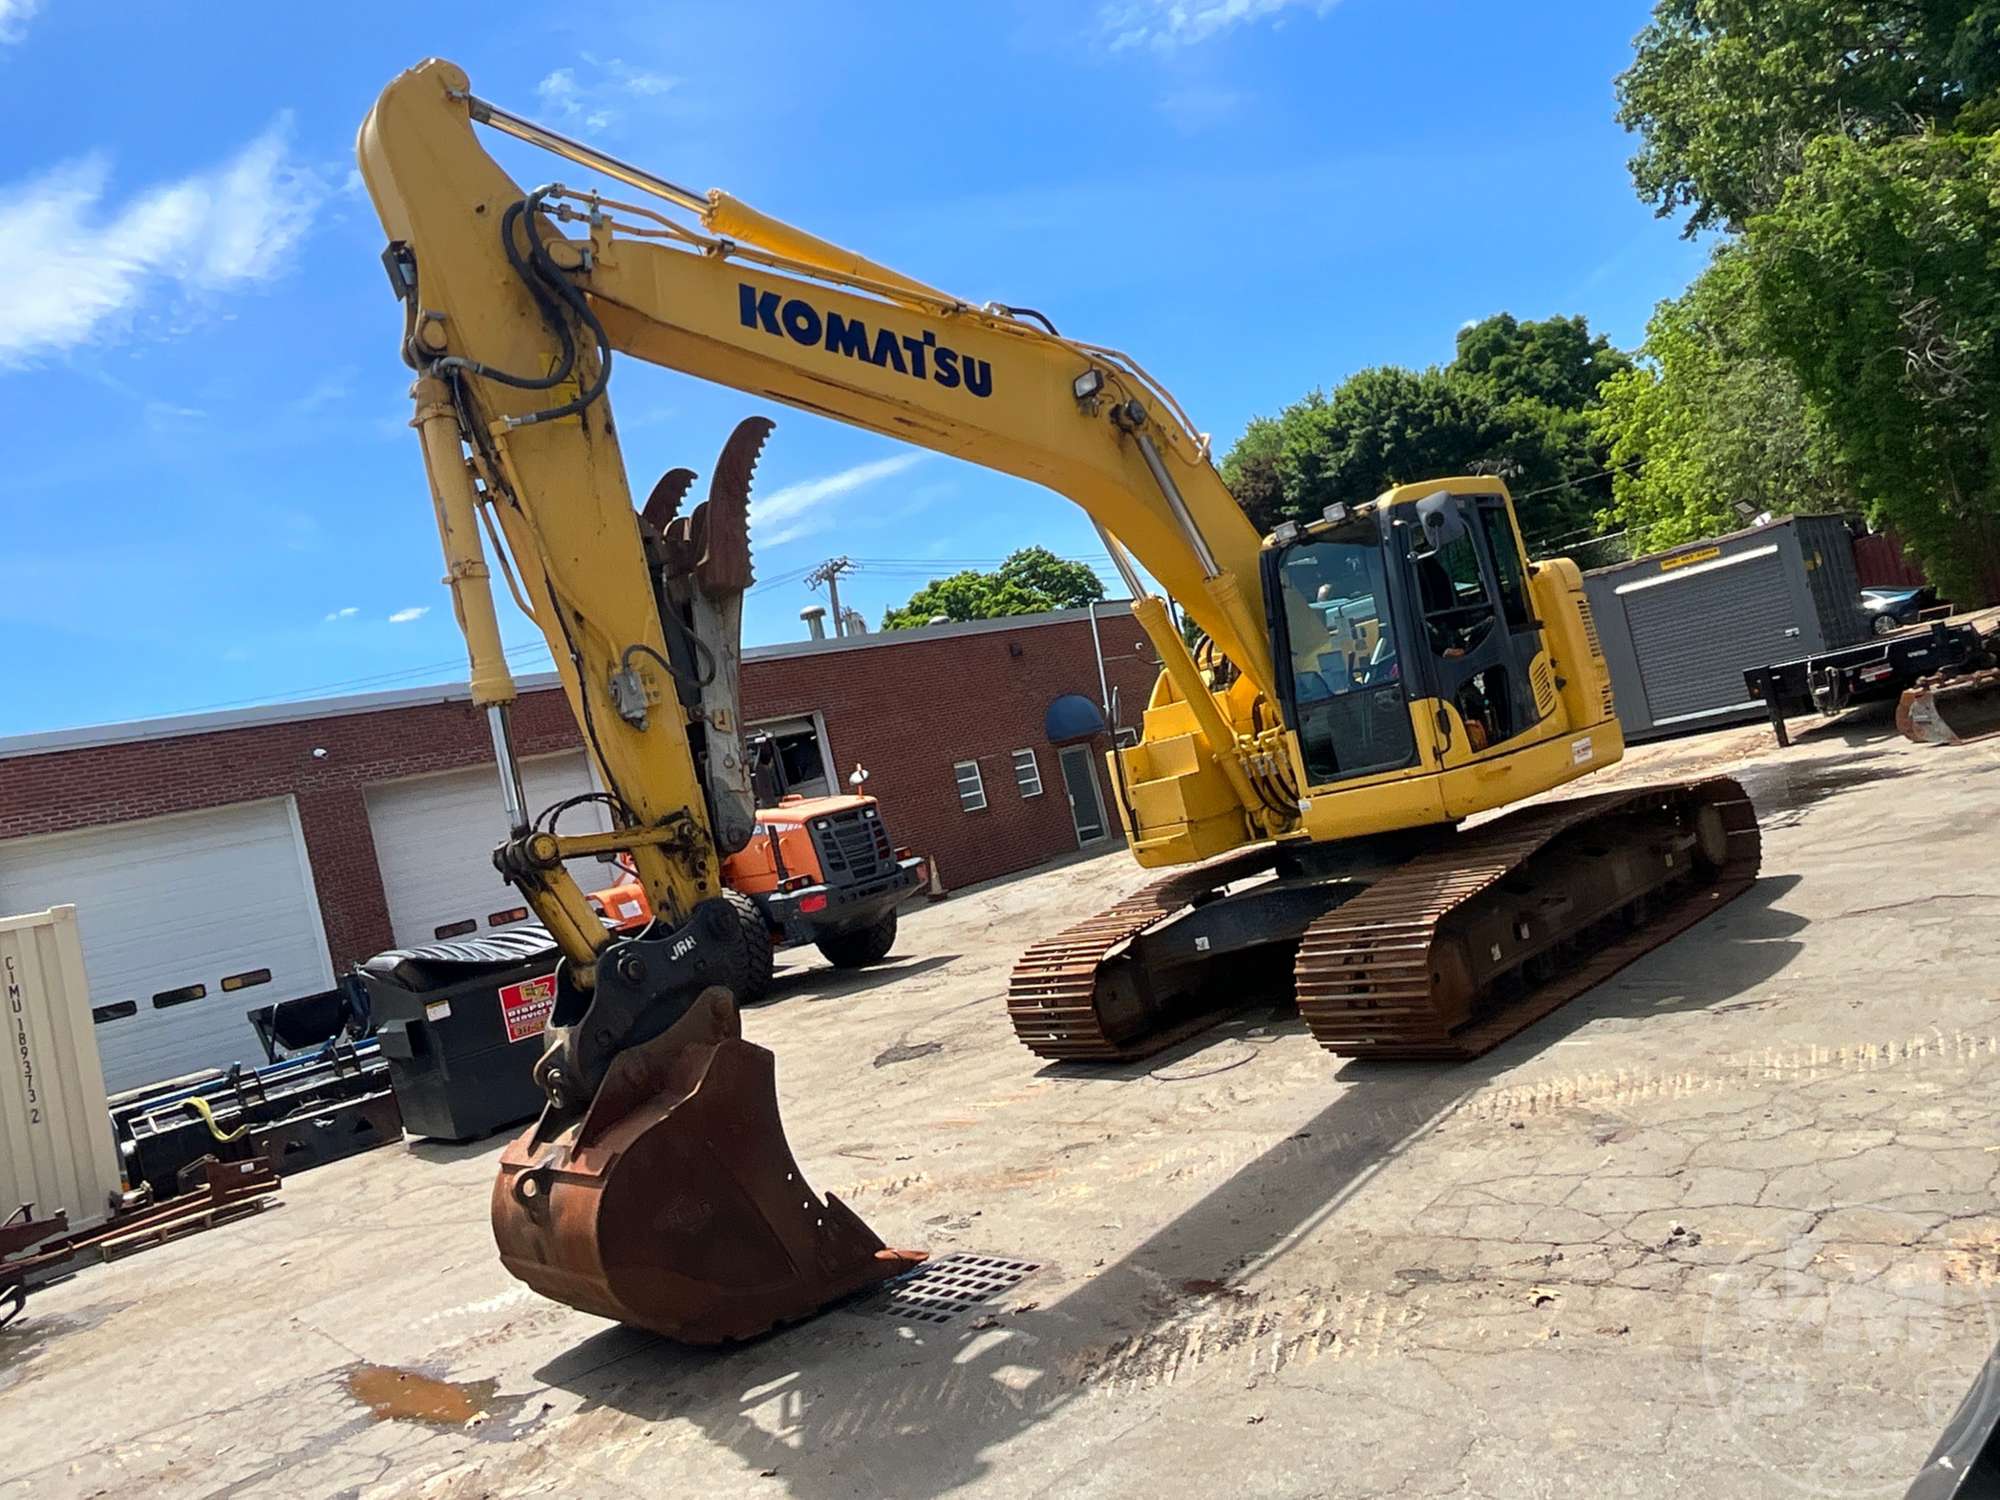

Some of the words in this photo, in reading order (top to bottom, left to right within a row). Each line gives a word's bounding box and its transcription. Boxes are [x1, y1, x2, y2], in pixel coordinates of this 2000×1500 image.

[738, 283, 993, 398] KOMATSU
[5, 956, 22, 1013] CIMU
[18, 1017, 37, 1103] 189373
[31, 1108, 41, 1124] 2
